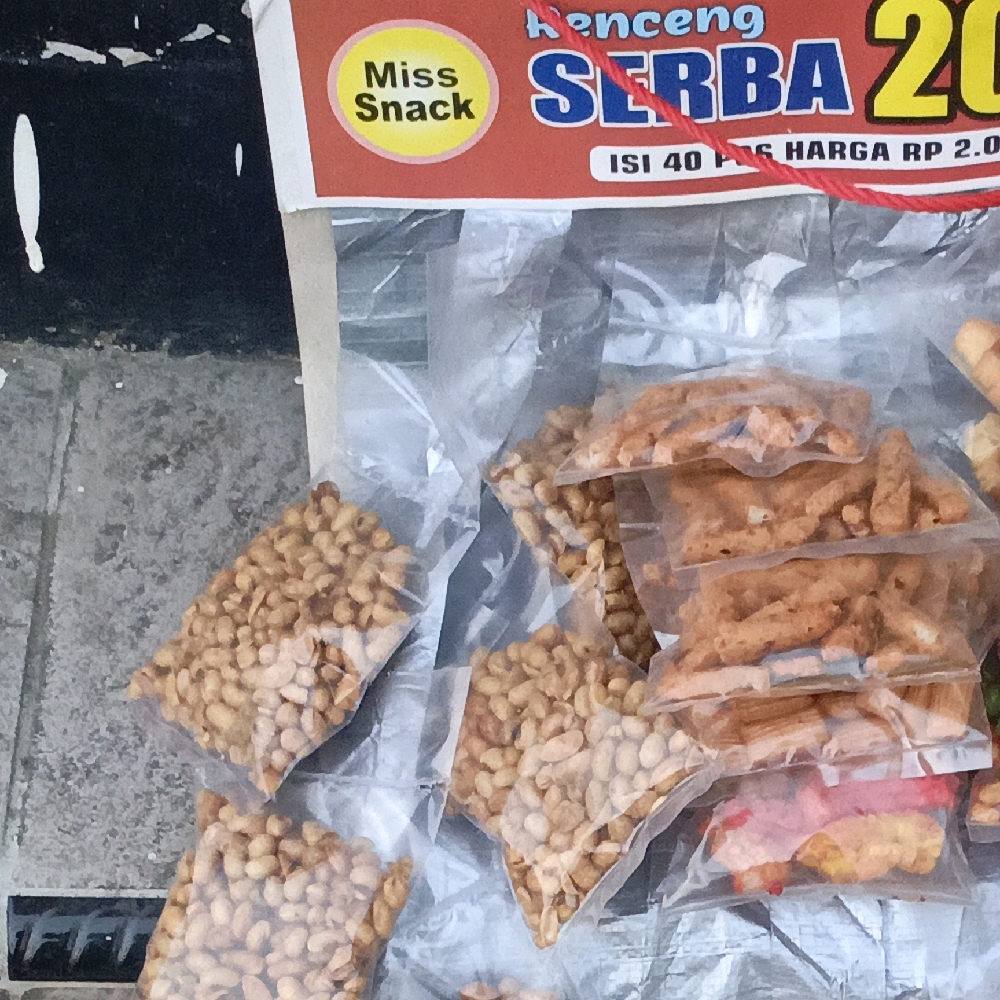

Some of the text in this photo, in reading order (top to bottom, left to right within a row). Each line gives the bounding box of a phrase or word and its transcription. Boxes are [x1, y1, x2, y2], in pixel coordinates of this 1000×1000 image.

[364, 60, 459, 89] Miss
[529, 38, 854, 128] SERBA
[354, 92, 477, 123] Snack
[610, 153, 651, 174] ISI
[663, 150, 702, 172] 40
[785, 140, 891, 162] HARGA
[902, 142, 943, 162] RP
